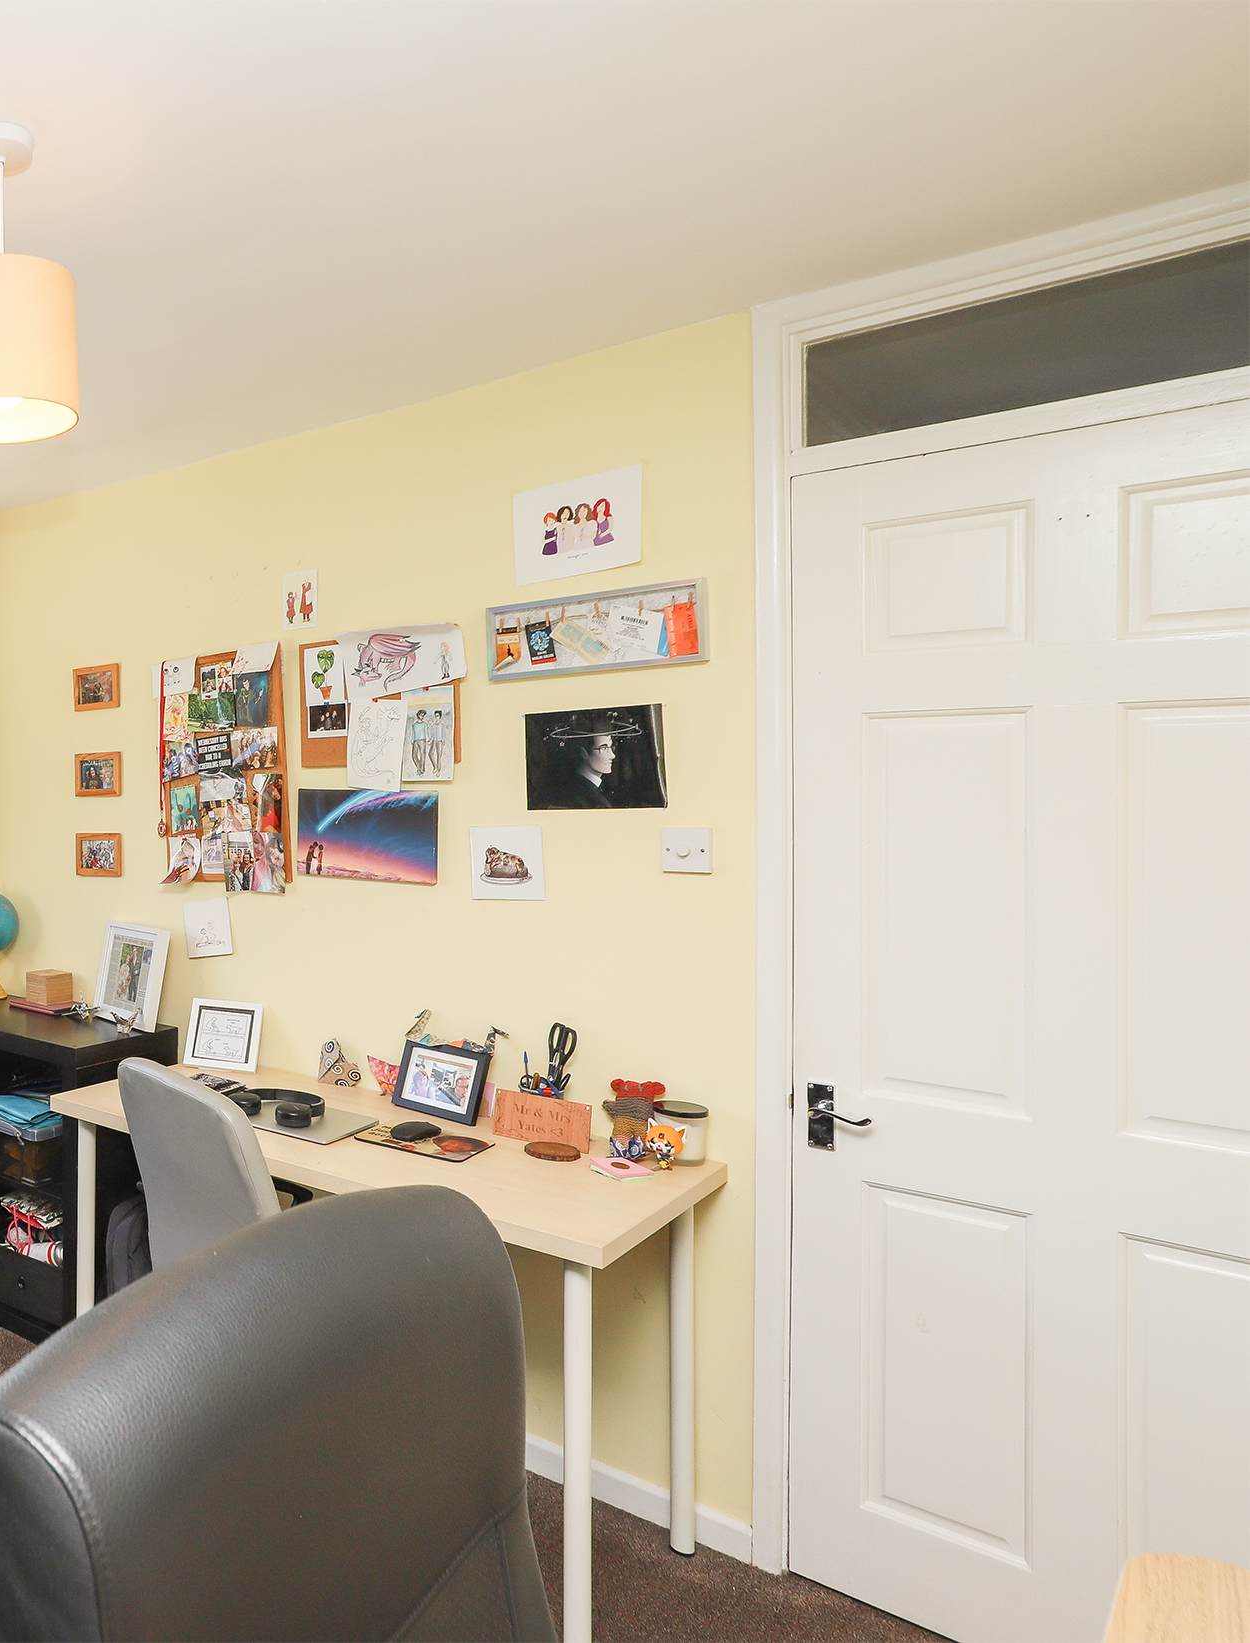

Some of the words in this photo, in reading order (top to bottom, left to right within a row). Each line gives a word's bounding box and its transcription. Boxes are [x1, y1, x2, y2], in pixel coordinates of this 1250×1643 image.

[514, 1103, 530, 1115] Mr
[534, 1107, 543, 1118] &
[548, 1110, 571, 1123] Mrs
[518, 1119, 546, 1134] Yates
[550, 1127, 563, 1138] <3
